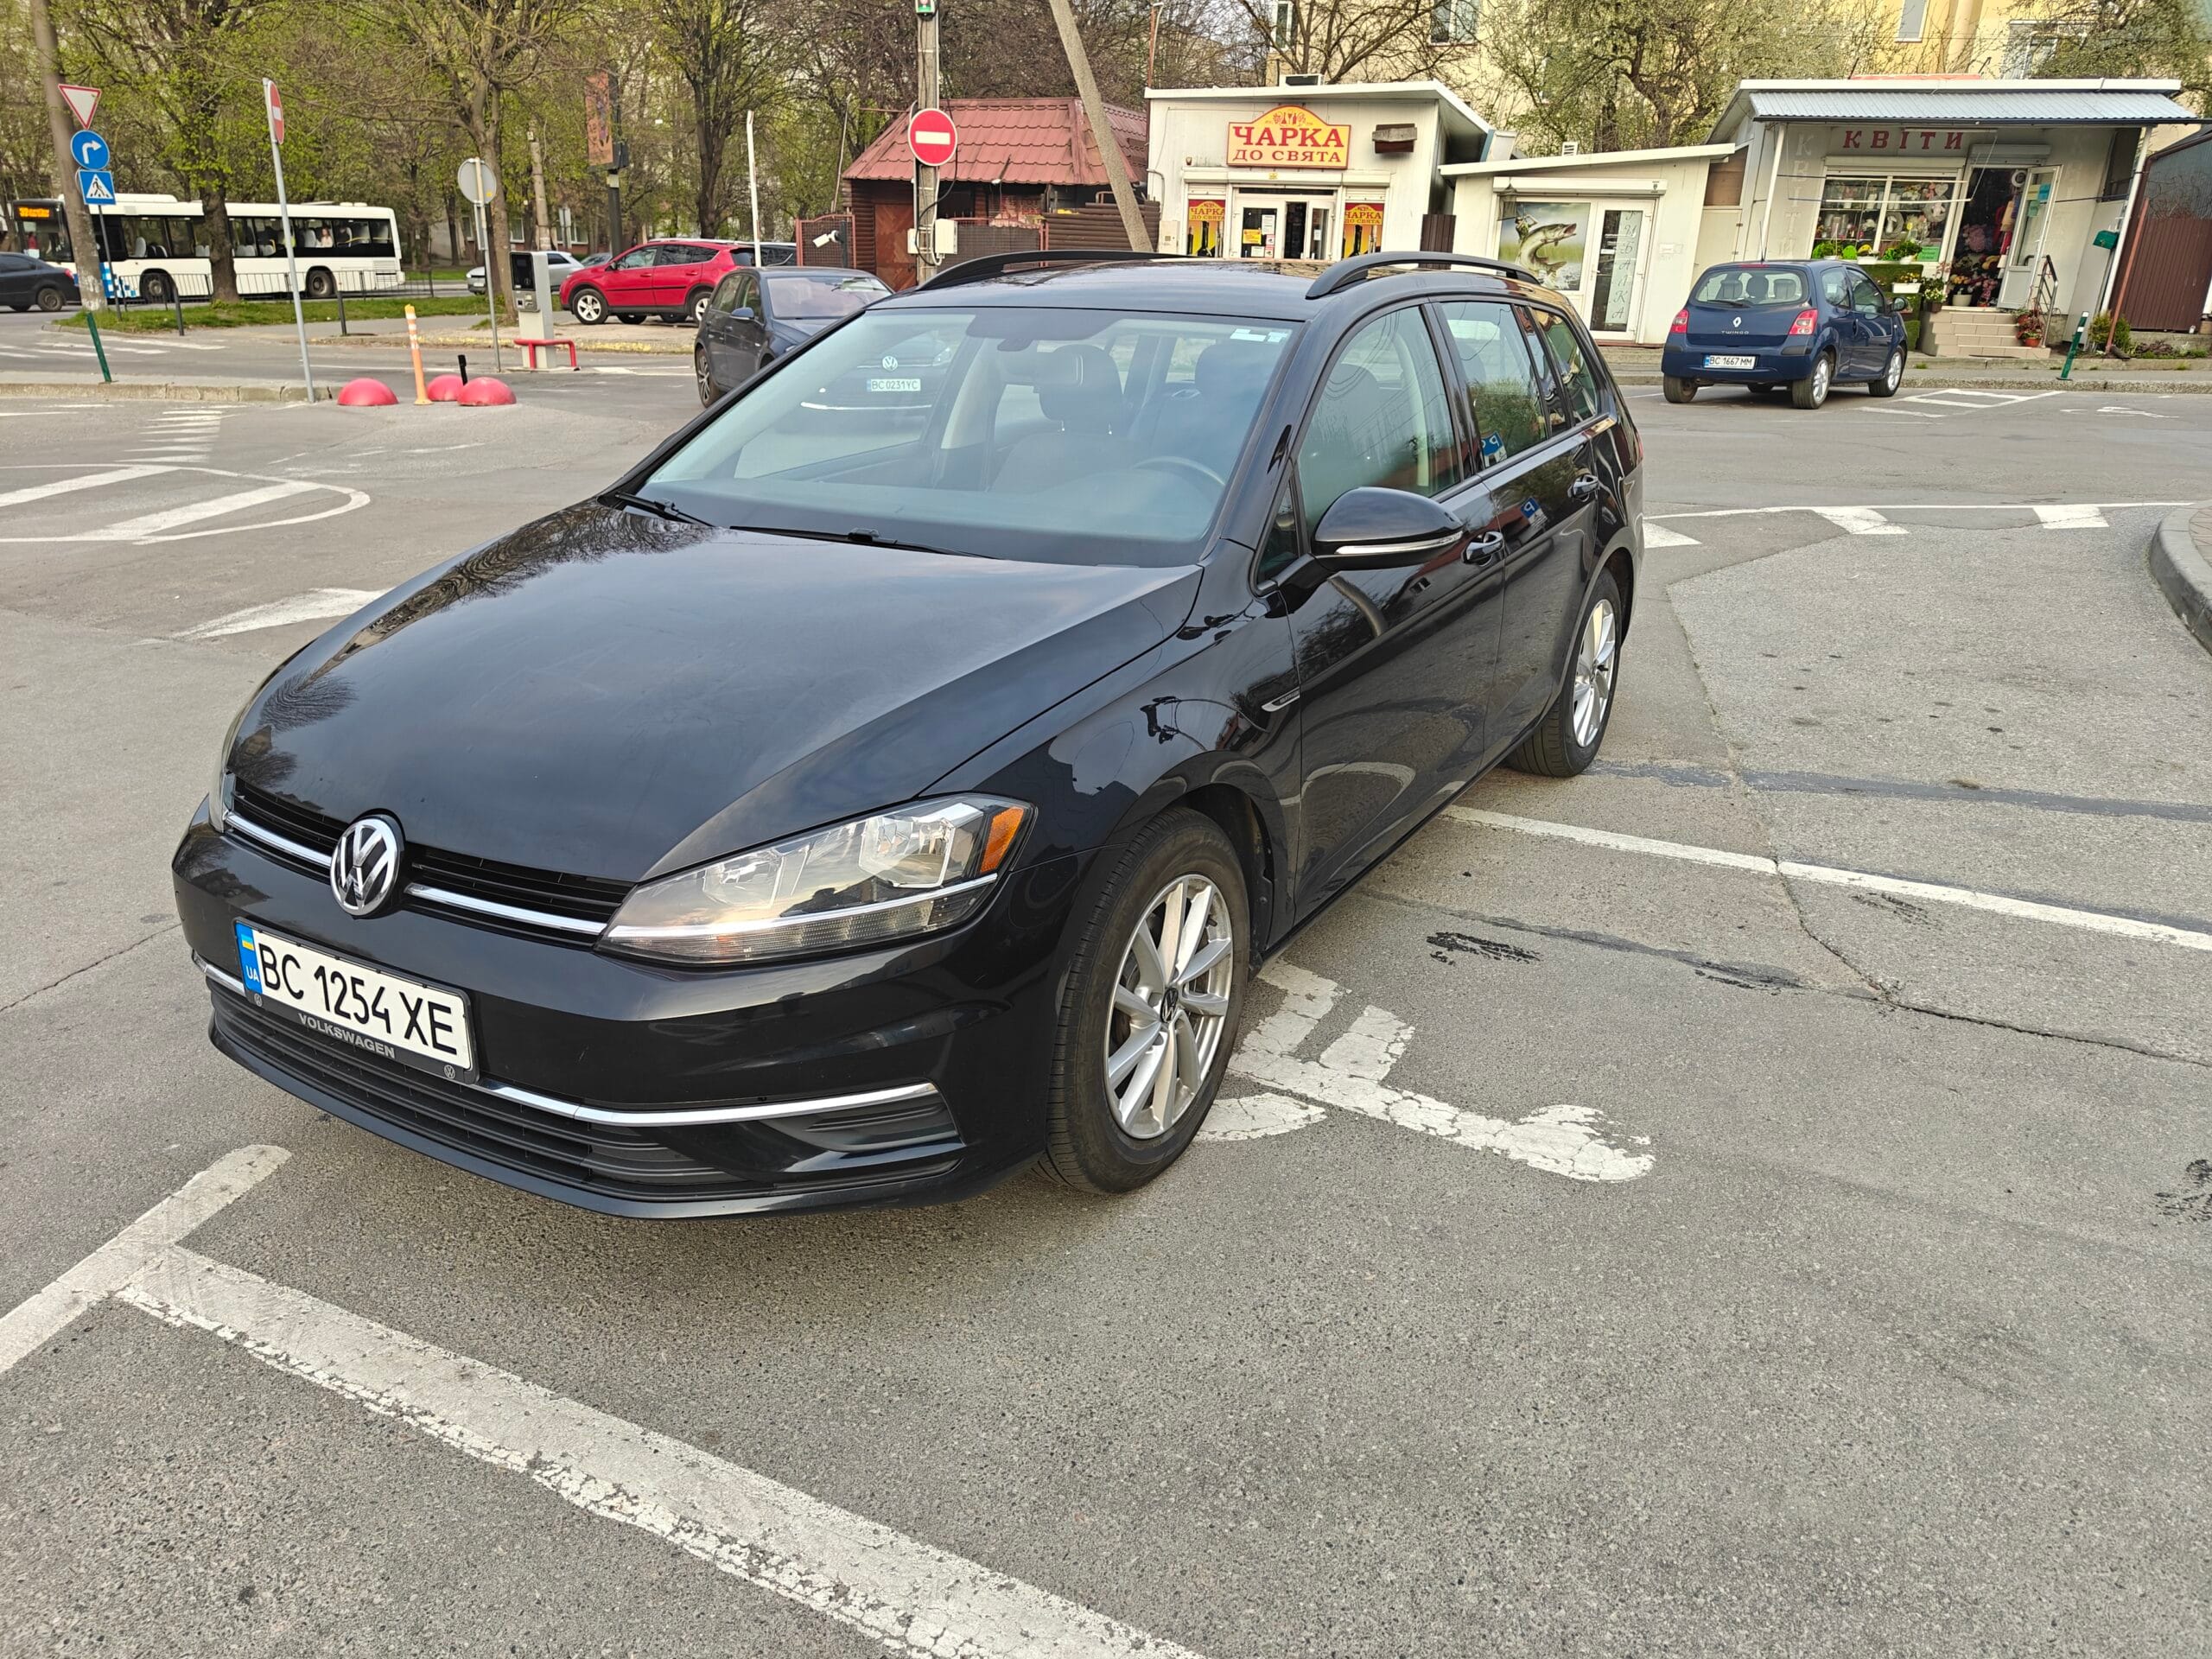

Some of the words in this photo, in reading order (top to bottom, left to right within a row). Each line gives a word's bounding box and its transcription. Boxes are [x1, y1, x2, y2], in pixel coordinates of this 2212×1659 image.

[1232, 125, 1344, 148] ЧАРКА
[1842, 130, 1964, 150] КВІТИ
[1232, 149, 1263, 162] ДО
[1271, 149, 1342, 163] СВЯТА
[1724, 357, 1739, 365] 1667
[872, 380, 886, 390] BC
[246, 964, 260, 982] UA
[258, 943, 304, 1000] BC
[314, 965, 391, 1034] 1254
[399, 991, 457, 1056] XE
[298, 1012, 396, 1059] VOLKSWAGEN
